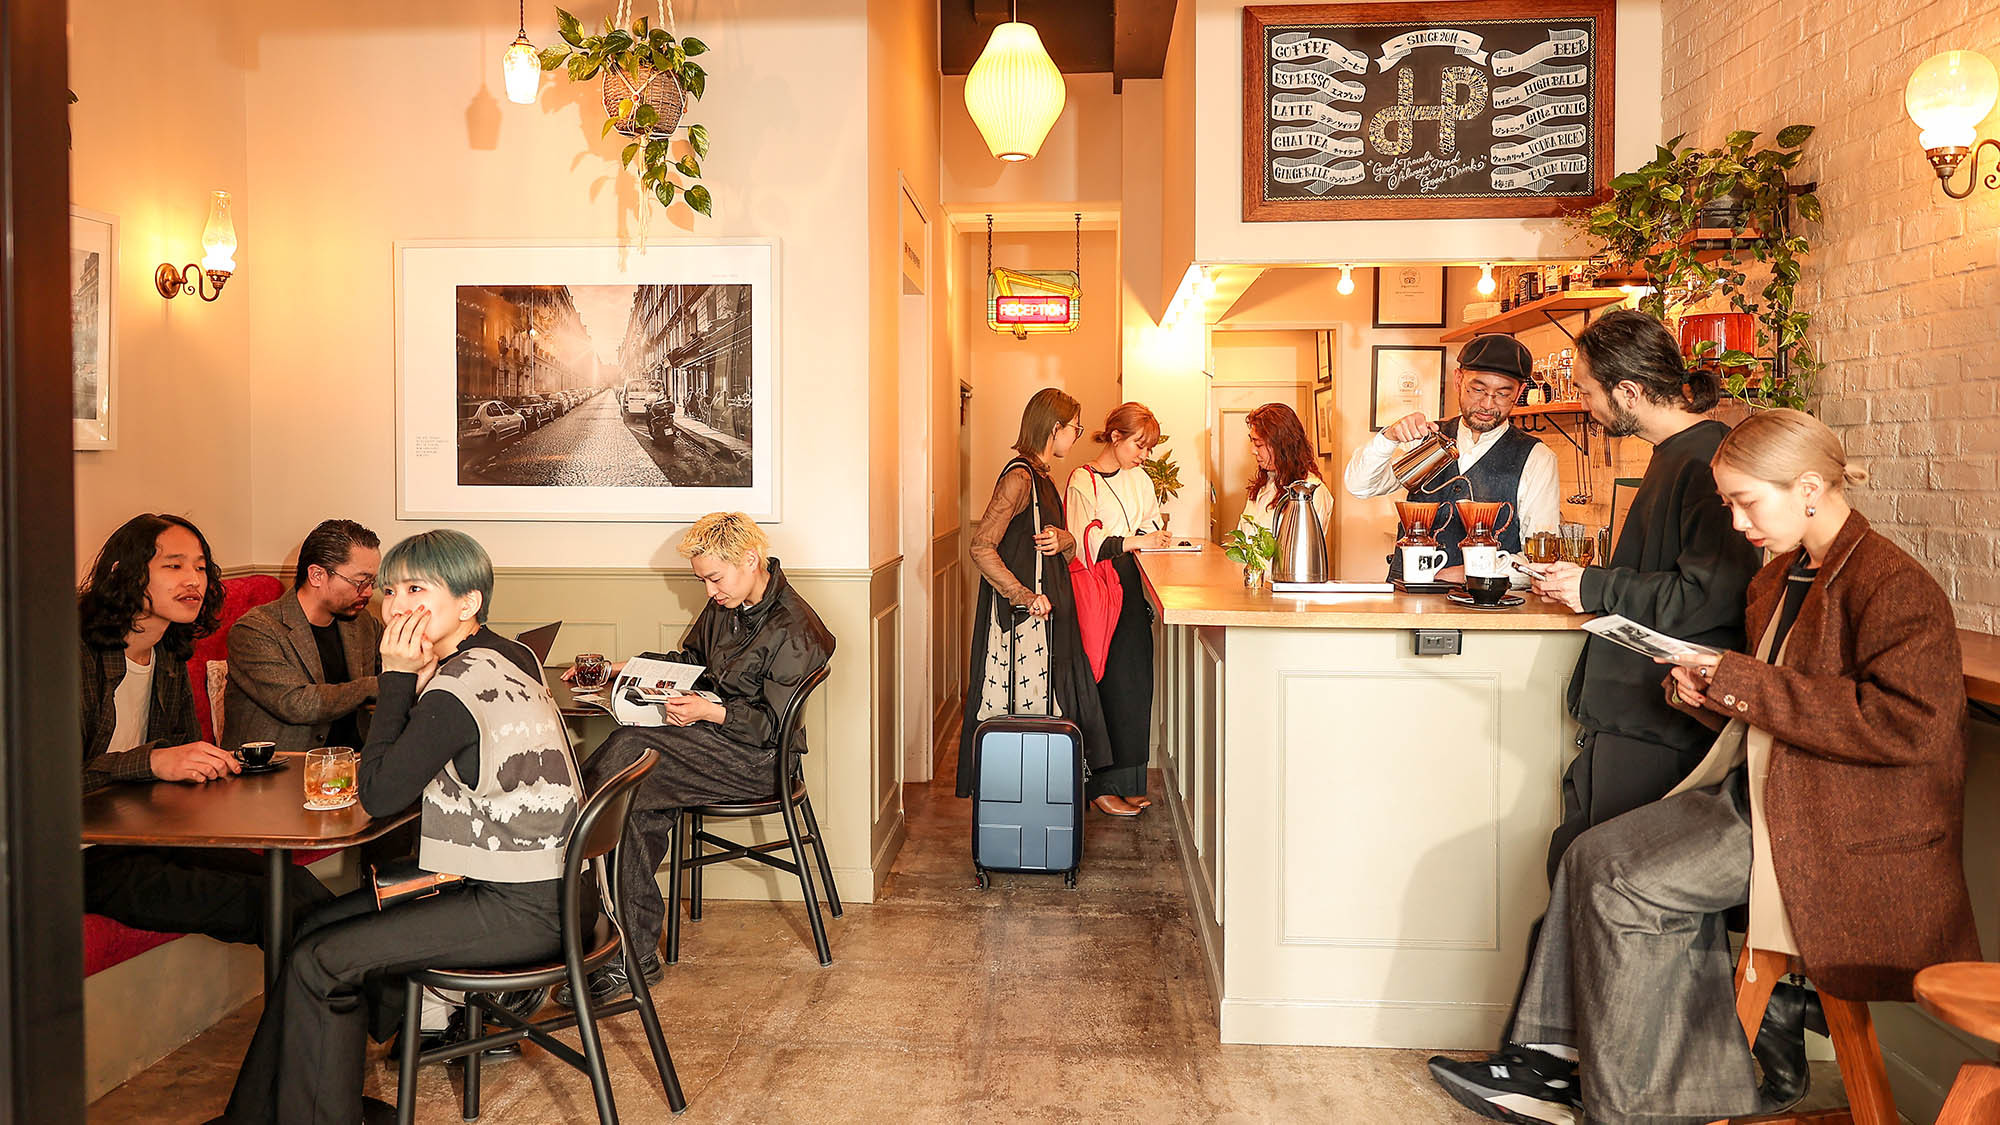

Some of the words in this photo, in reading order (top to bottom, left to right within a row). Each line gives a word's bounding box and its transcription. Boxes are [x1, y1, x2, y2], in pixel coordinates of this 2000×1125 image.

[1407, 32, 1438, 45] SINCE
[1275, 41, 1331, 58] COFFEE
[1553, 40, 1587, 55] BEER
[1341, 56, 1365, 71] コーヒー
[1496, 66, 1514, 75] ビール
[1275, 72, 1331, 89] ESPRESSO
[1274, 105, 1313, 117] LATTE
[1551, 101, 1586, 116] TONIC
[1274, 134, 1303, 147] CHAI
[1306, 134, 1328, 149] TEA
[1528, 136, 1557, 155] VODKA
[1430, 150, 1461, 171] Need
[1560, 159, 1586, 173] WINE
[1420, 168, 1447, 193] Good
[1000, 303, 1067, 317] RECEPTION
